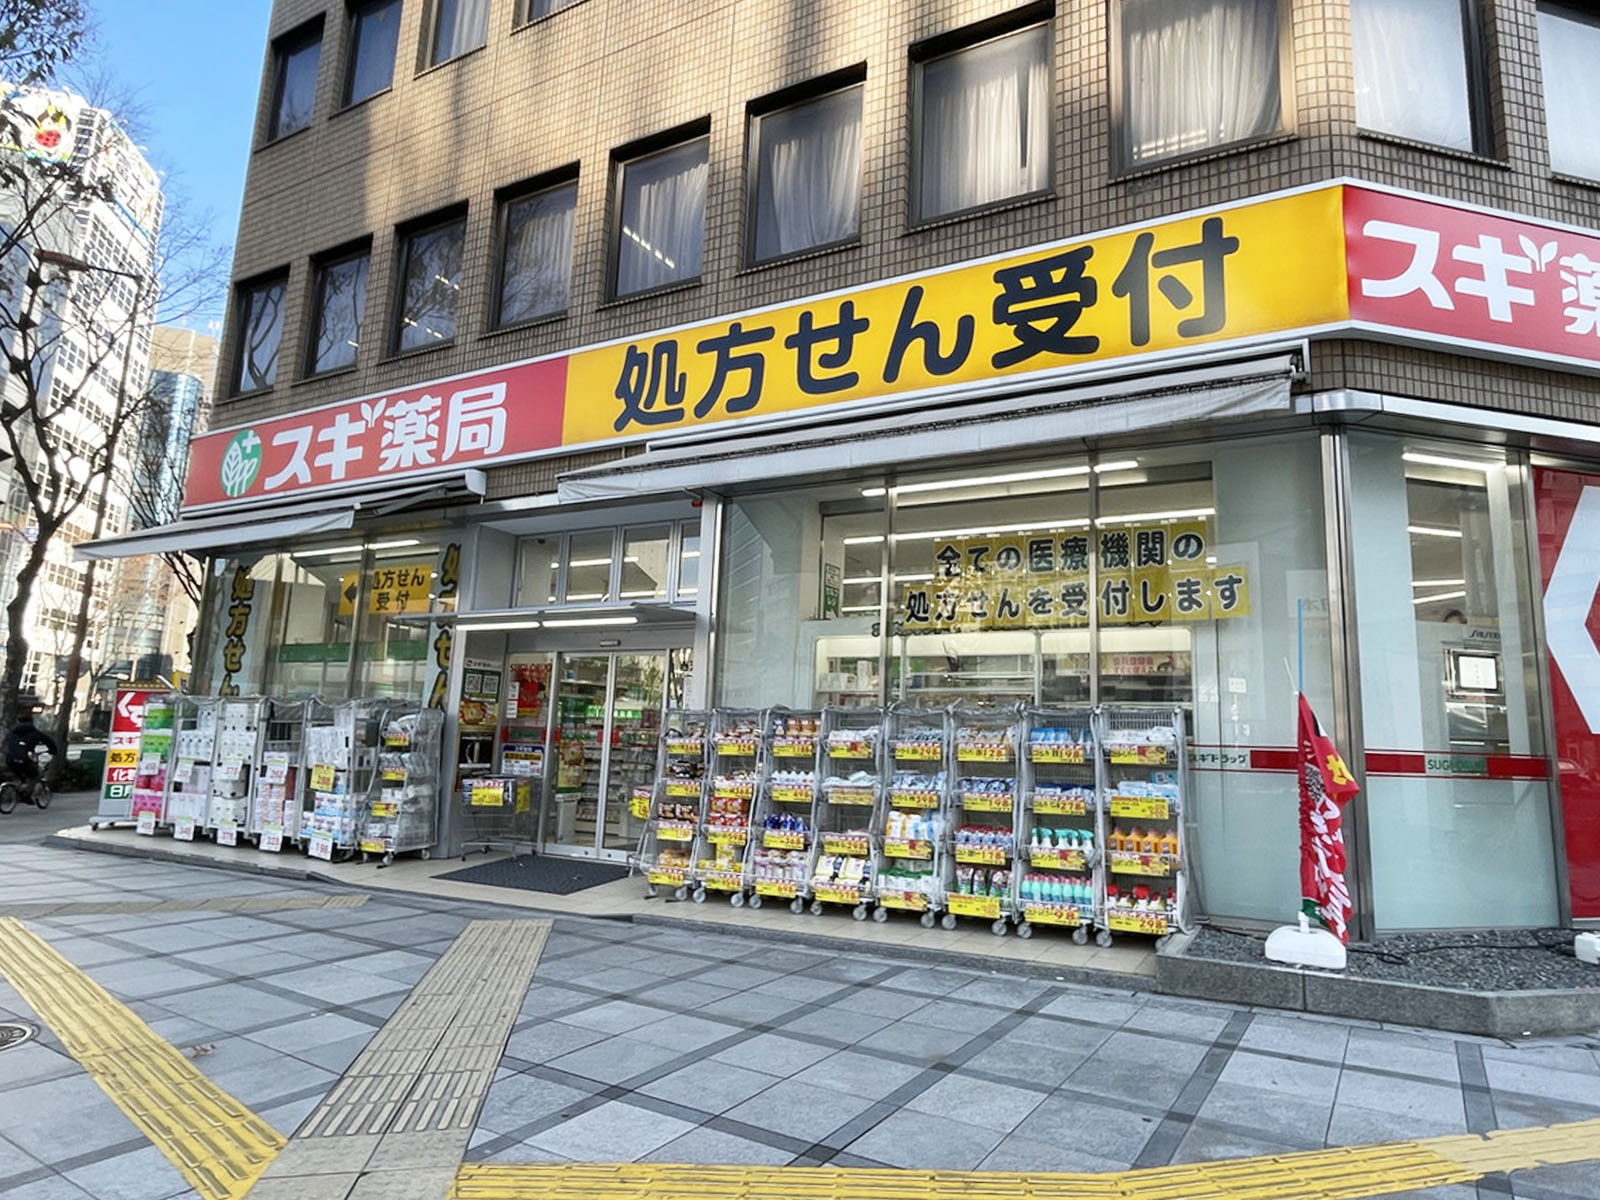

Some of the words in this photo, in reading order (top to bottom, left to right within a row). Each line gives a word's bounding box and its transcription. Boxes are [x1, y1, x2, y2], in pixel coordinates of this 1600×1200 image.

[614, 217, 1240, 432] 処方せん受付
[264, 382, 508, 491] スギ薬局
[936, 530, 1204, 577] 全ての医療機関の
[375, 590, 410, 614] 受付
[905, 574, 1243, 623] 処方せんを受付します
